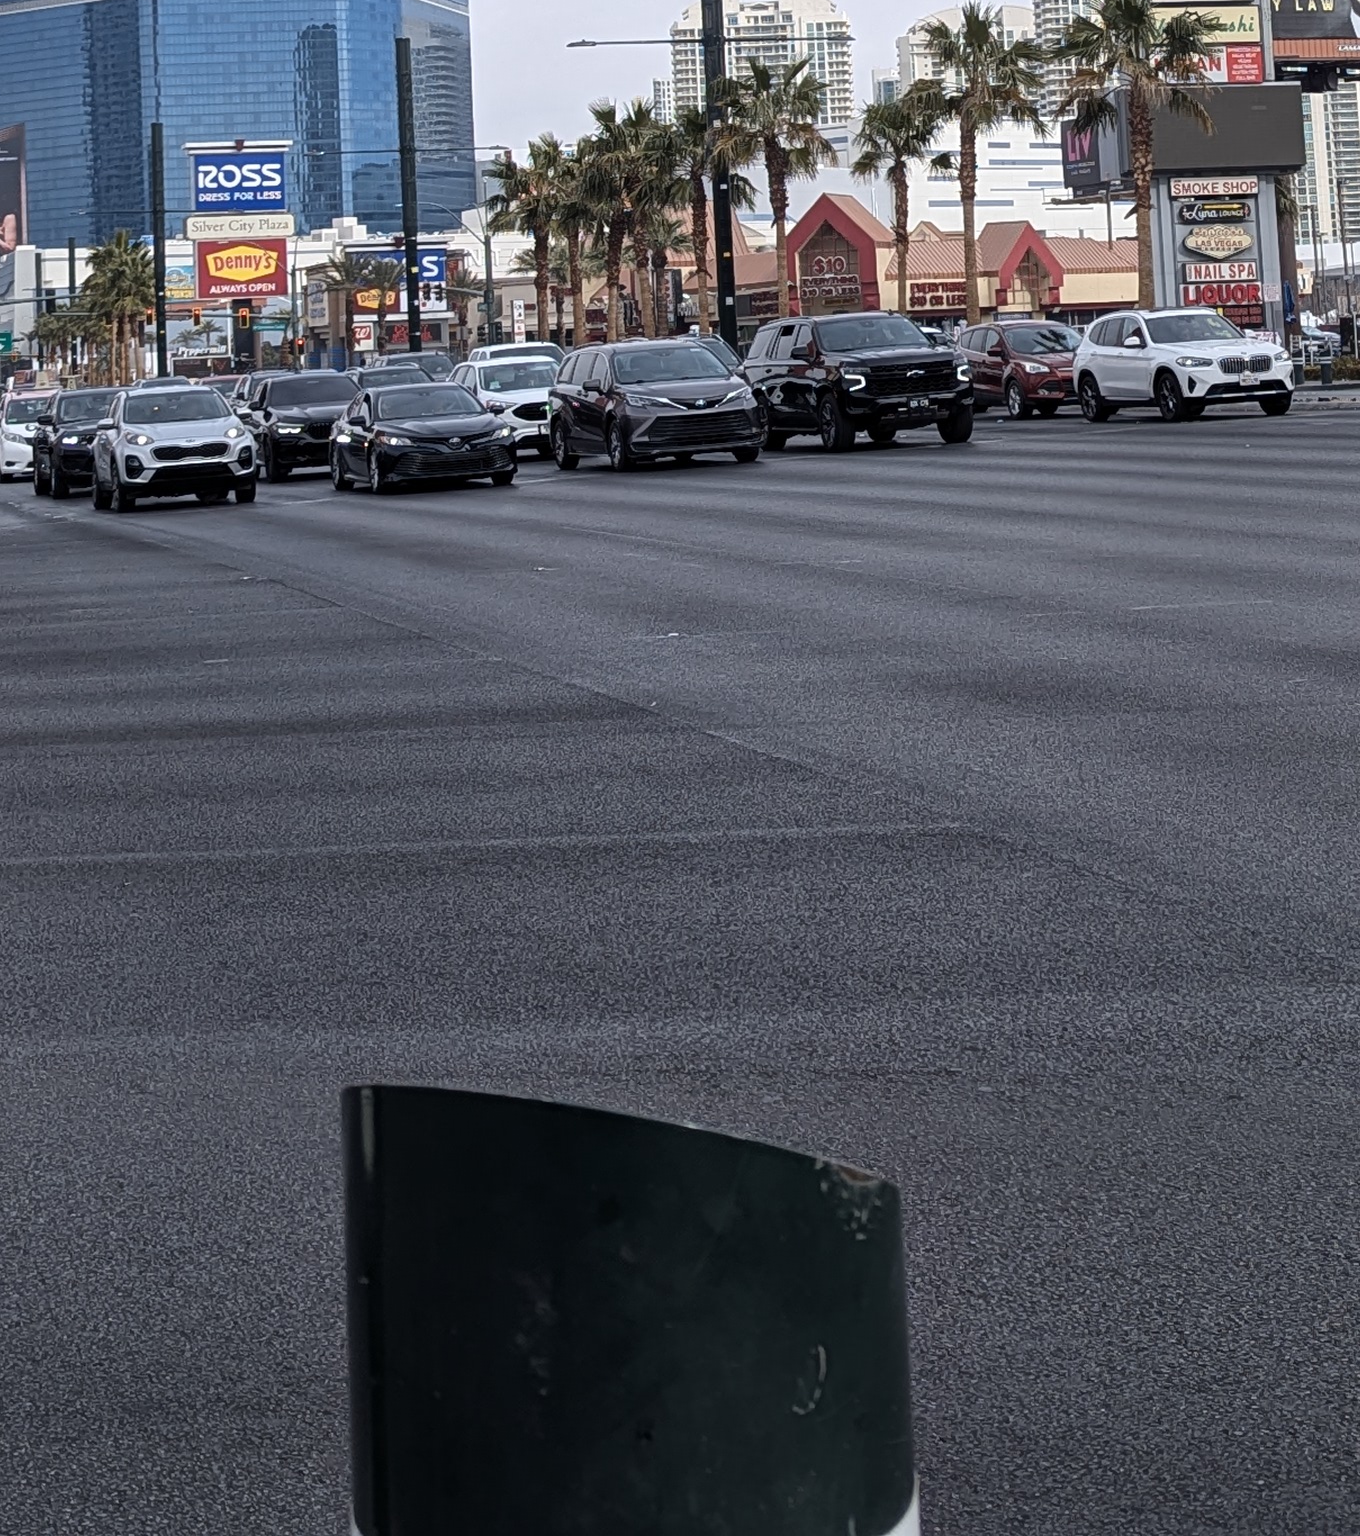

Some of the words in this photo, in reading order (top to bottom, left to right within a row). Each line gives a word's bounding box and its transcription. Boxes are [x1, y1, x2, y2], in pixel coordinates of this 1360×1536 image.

[197, 163, 282, 189] ROSS
[1172, 181, 1220, 195] SMOKE
[1222, 181, 1258, 193] SHOP
[198, 192, 231, 202] DRESS
[233, 192, 255, 200] FOR
[256, 190, 283, 200] LESS
[1219, 209, 1245, 218] LOUNGE
[191, 220, 225, 233] Silver
[228, 219, 255, 234] City
[258, 218, 289, 231] Plaza
[212, 252, 273, 273] Denny's
[813, 255, 847, 276] $10
[1194, 265, 1226, 280] NAIL
[1228, 263, 1256, 279] SPA
[801, 274, 860, 286] EVERYTHING
[209, 283, 248, 295] ALWAYS
[248, 282, 276, 293] OPEN
[1182, 284, 1263, 306] LIQUOR
[946, 294, 967, 306] LES
[178, 344, 227, 358] Peppermill
